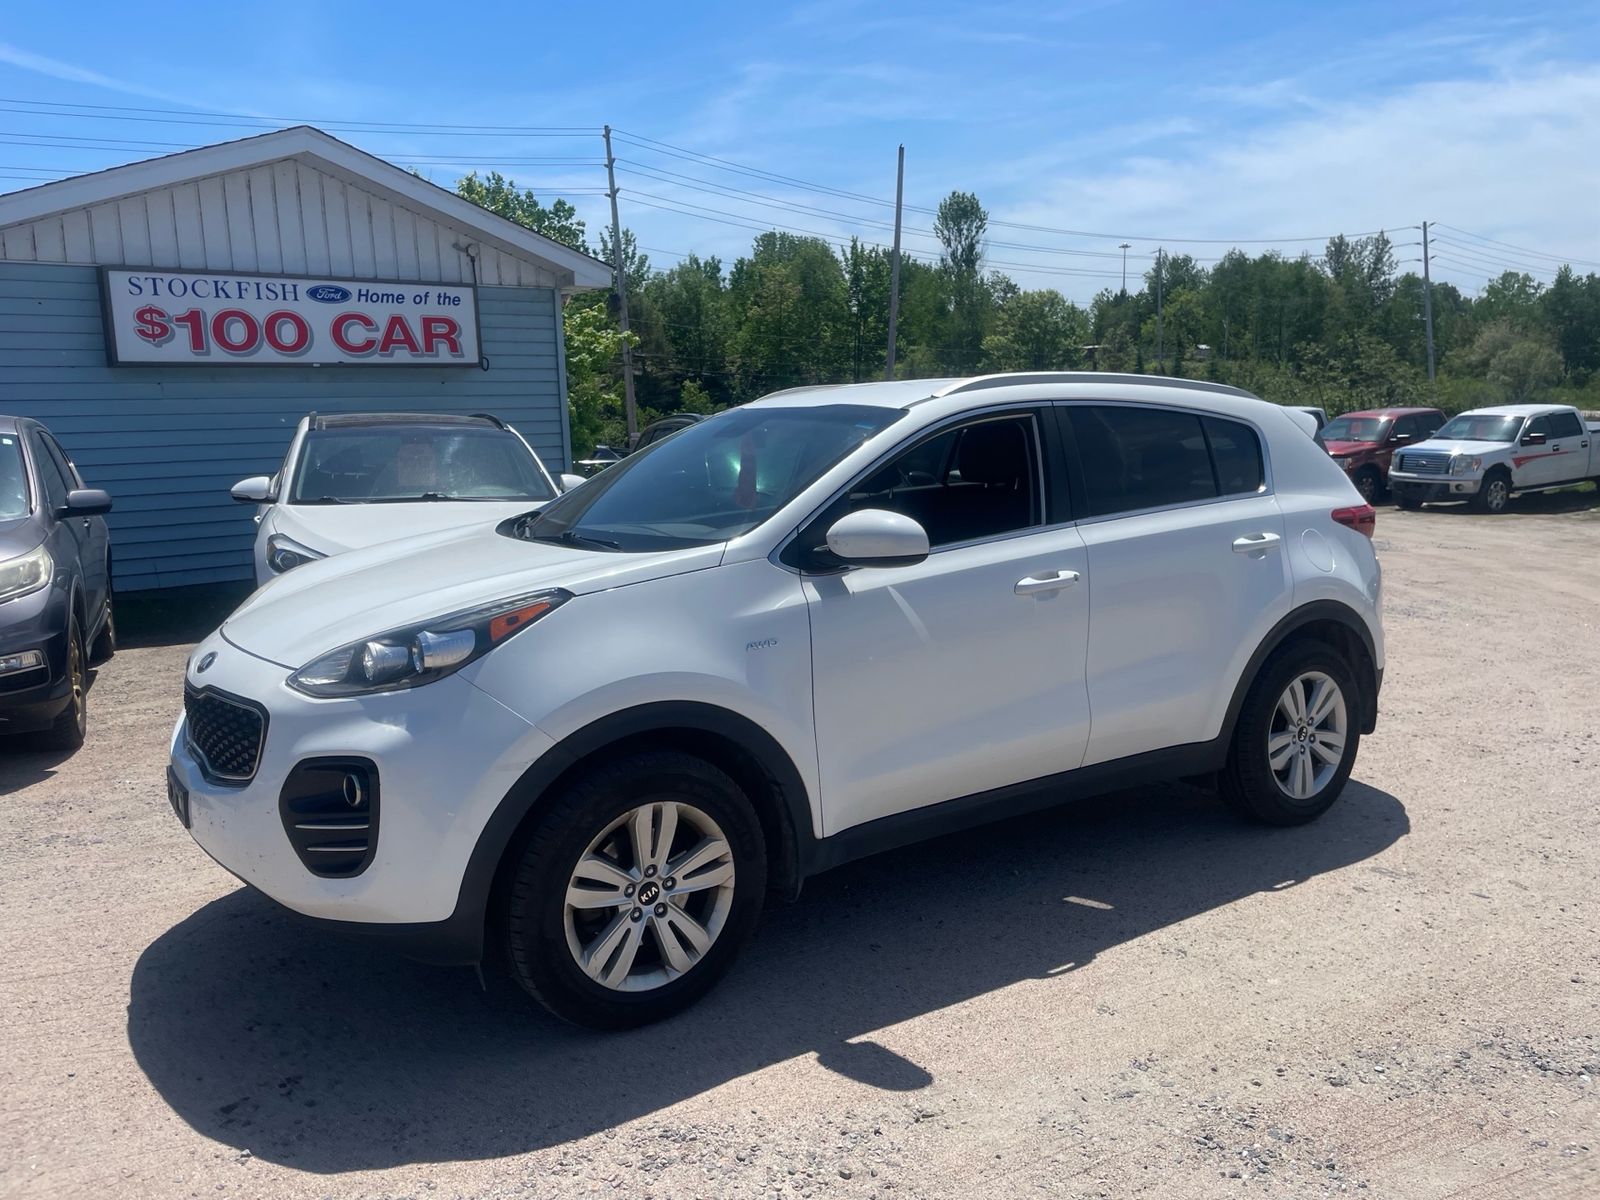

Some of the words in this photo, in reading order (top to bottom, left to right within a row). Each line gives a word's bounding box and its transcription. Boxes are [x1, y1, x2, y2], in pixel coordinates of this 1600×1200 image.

[128, 276, 299, 301] STOCKFISH
[357, 288, 405, 304] Home
[413, 291, 430, 305] of
[437, 292, 461, 306] the
[134, 304, 314, 355] $100
[330, 311, 463, 356] CAR
[640, 886, 658, 903] KIA
